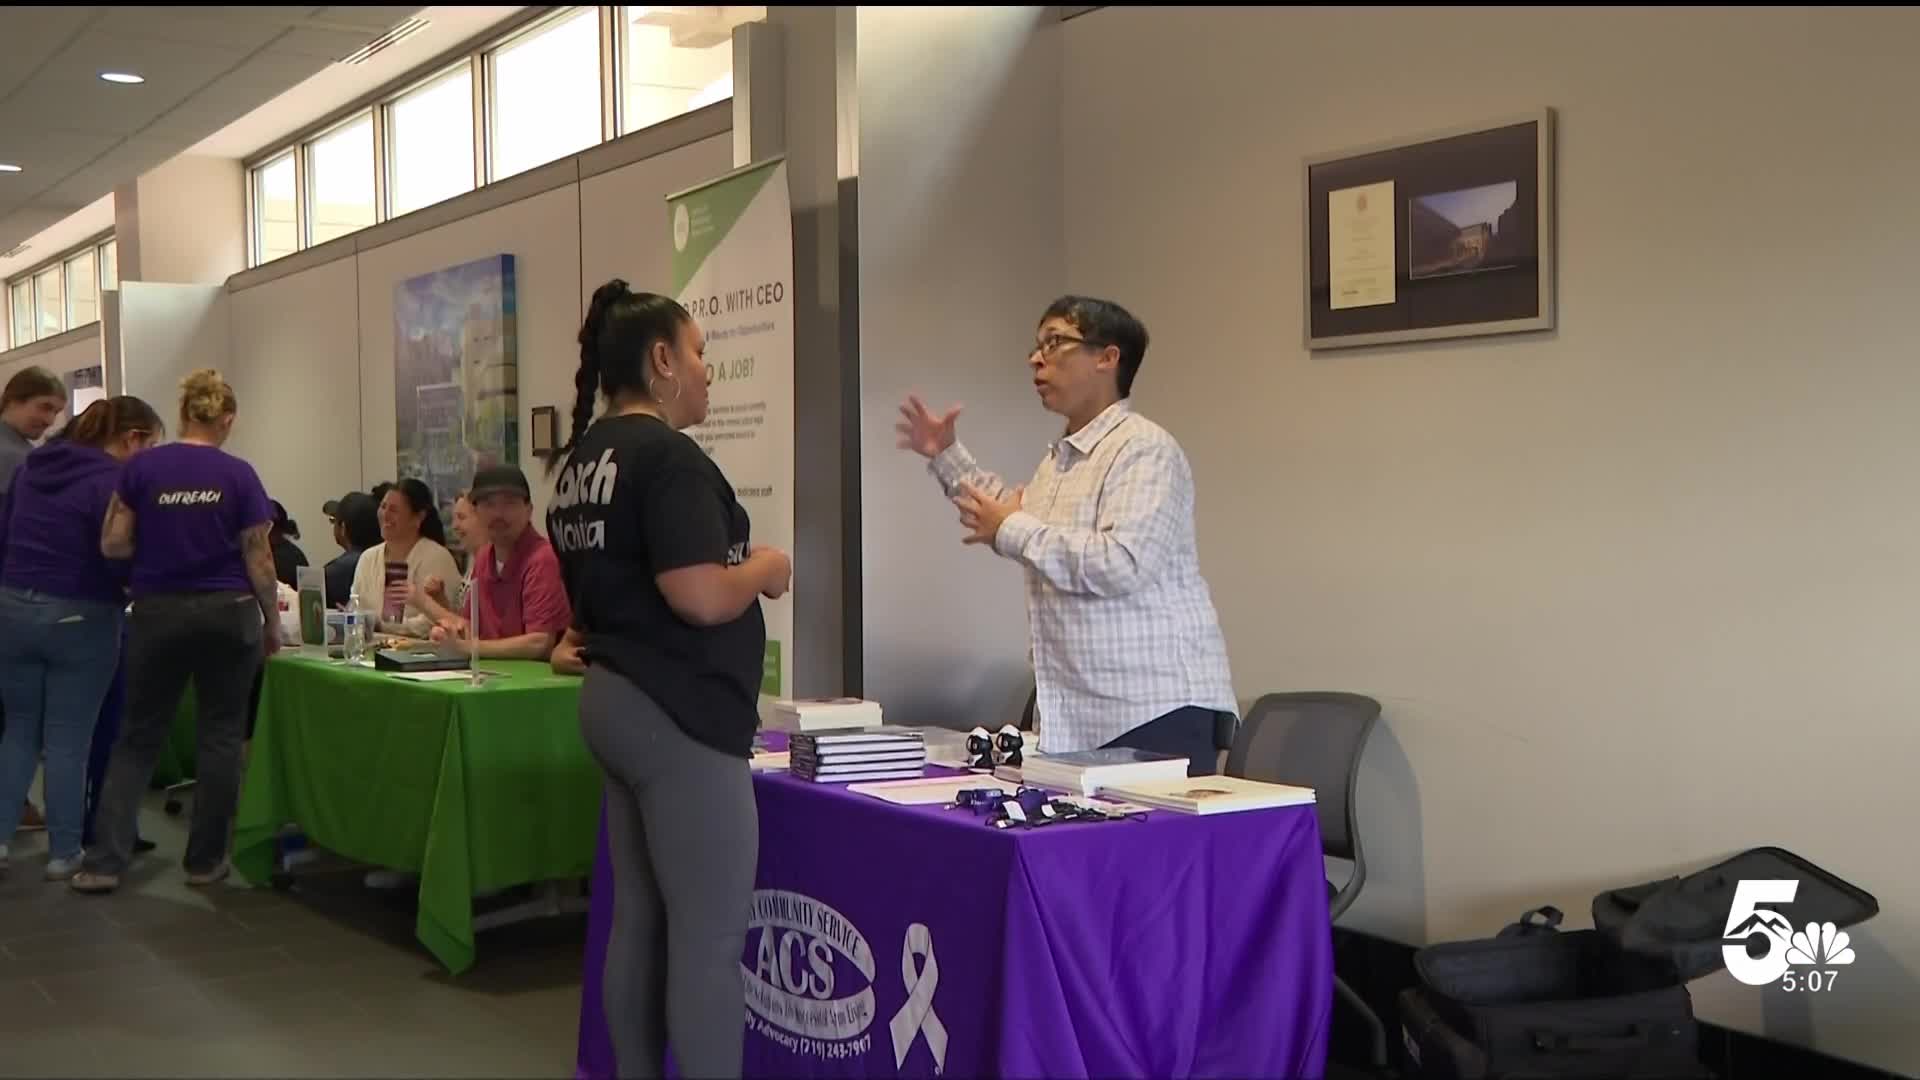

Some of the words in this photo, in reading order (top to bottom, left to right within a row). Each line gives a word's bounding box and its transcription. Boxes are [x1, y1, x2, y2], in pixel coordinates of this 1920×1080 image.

[726, 288, 753, 312] WITH
[757, 281, 784, 305] CEO
[718, 361, 727, 381] A
[729, 355, 754, 380] JOB?
[158, 490, 221, 506] OUTREACH
[758, 896, 814, 928] COMMUNITY
[817, 907, 861, 957] SERVICE
[757, 926, 835, 999] ACS
[757, 1019, 798, 1054] Advocacy
[800, 1037, 825, 1061] (719)
[827, 1034, 871, 1059] 243-7907
